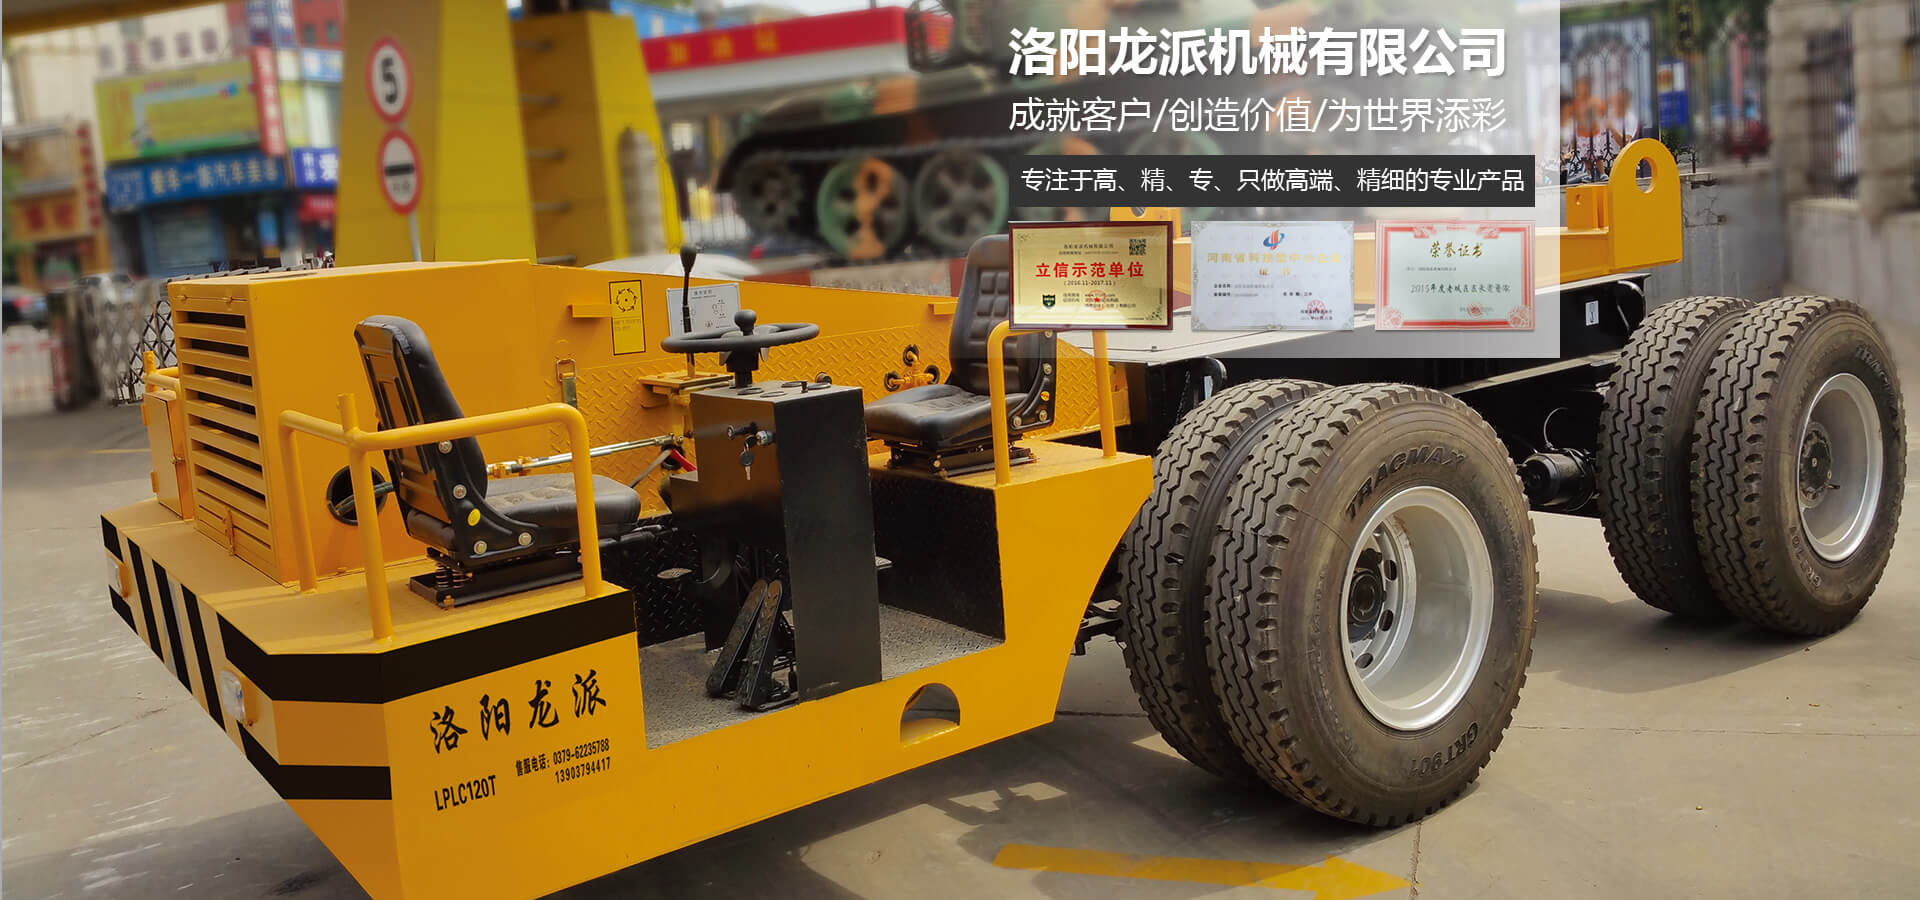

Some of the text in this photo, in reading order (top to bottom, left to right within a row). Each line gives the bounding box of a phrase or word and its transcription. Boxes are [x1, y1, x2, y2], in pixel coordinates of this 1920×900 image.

[381, 57, 398, 104] 5
[1344, 444, 1467, 519] TRACMAX
[430, 669, 606, 754] 洛阳龙派
[434, 774, 497, 811] LPLC120T
[555, 756, 611, 784] 13903794417
